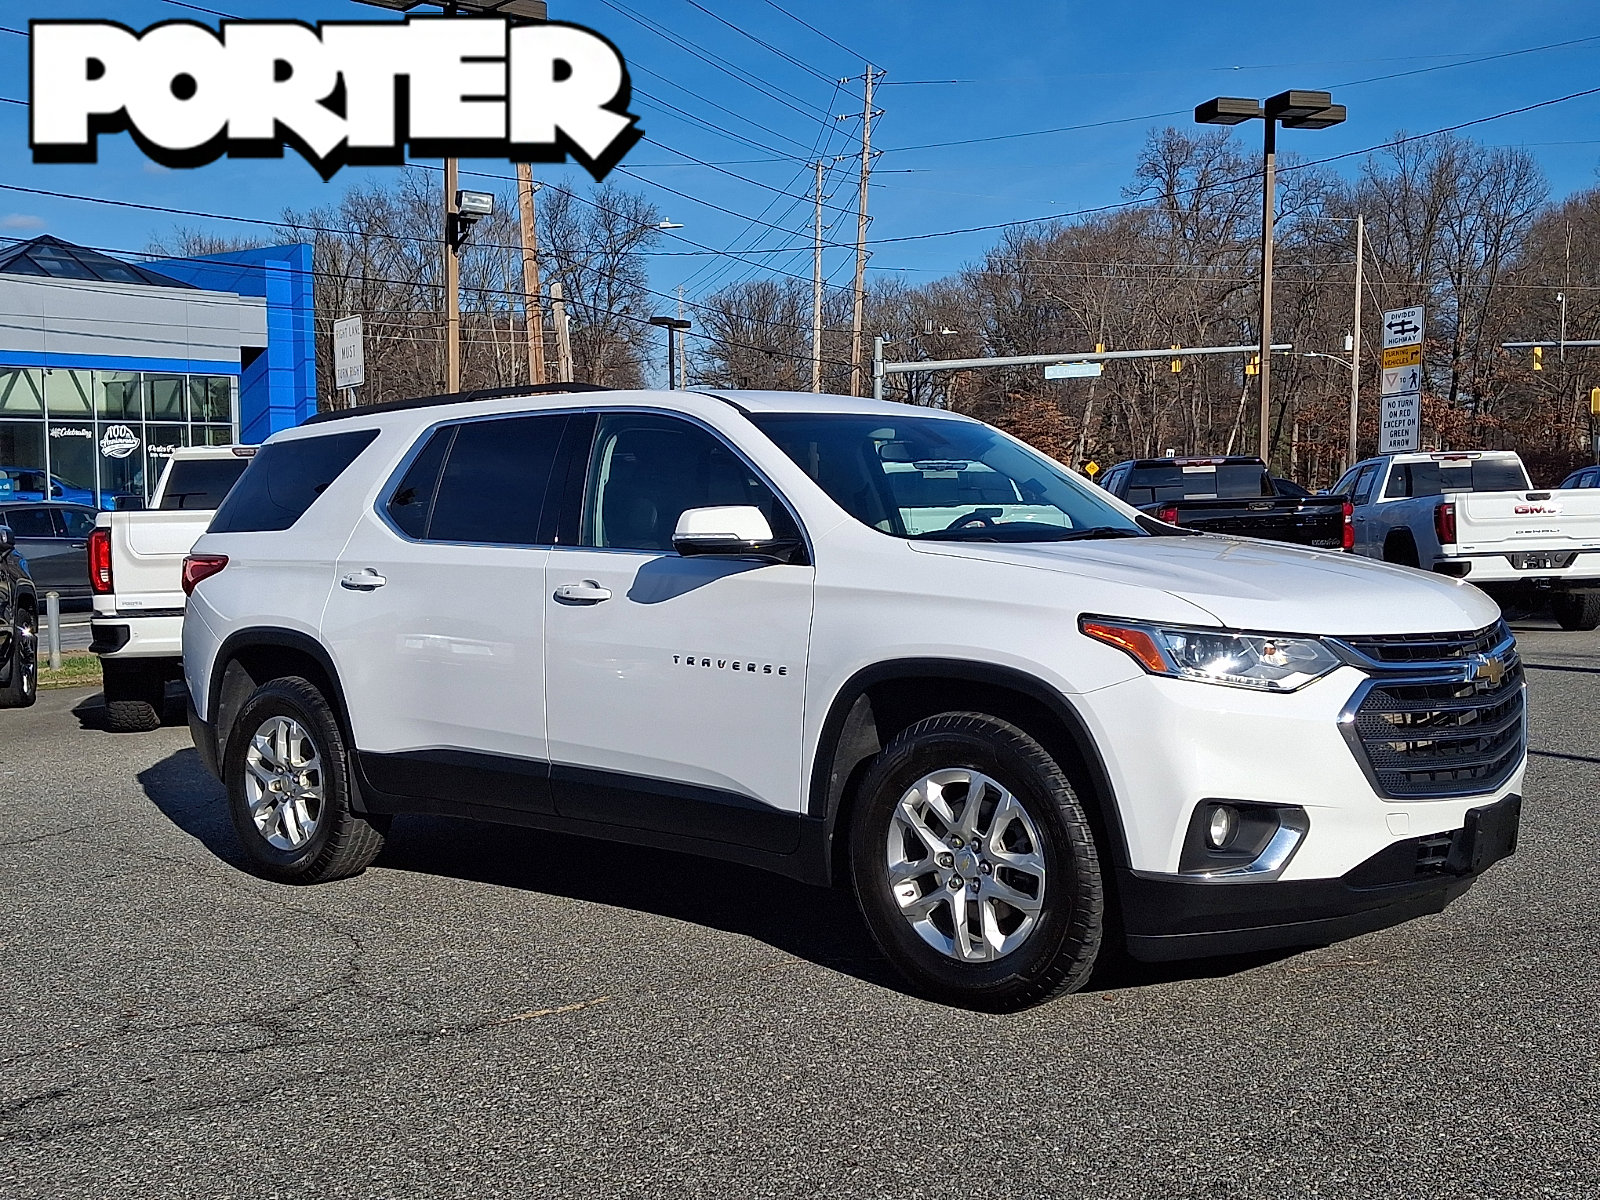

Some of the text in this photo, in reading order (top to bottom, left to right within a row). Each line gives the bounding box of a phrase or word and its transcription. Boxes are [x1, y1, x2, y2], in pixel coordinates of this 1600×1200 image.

[1391, 310, 1415, 320] DIVIDED
[336, 324, 361, 339] RIGHT LANE
[1388, 335, 1417, 345] HIGHWAY
[341, 344, 356, 360] MUST
[1385, 349, 1409, 358] TURNING
[1385, 357, 1409, 366] VEHICLES
[337, 364, 362, 380] TURN RIGHT
[1387, 399, 1414, 409] NO TURN
[1389, 409, 1411, 419] ON RED
[1383, 418, 1416, 428] EXCEPT ON
[1389, 429, 1410, 438] GREEN
[1388, 438, 1410, 448] ARROW
[672, 654, 787, 676] TRAVERSE
